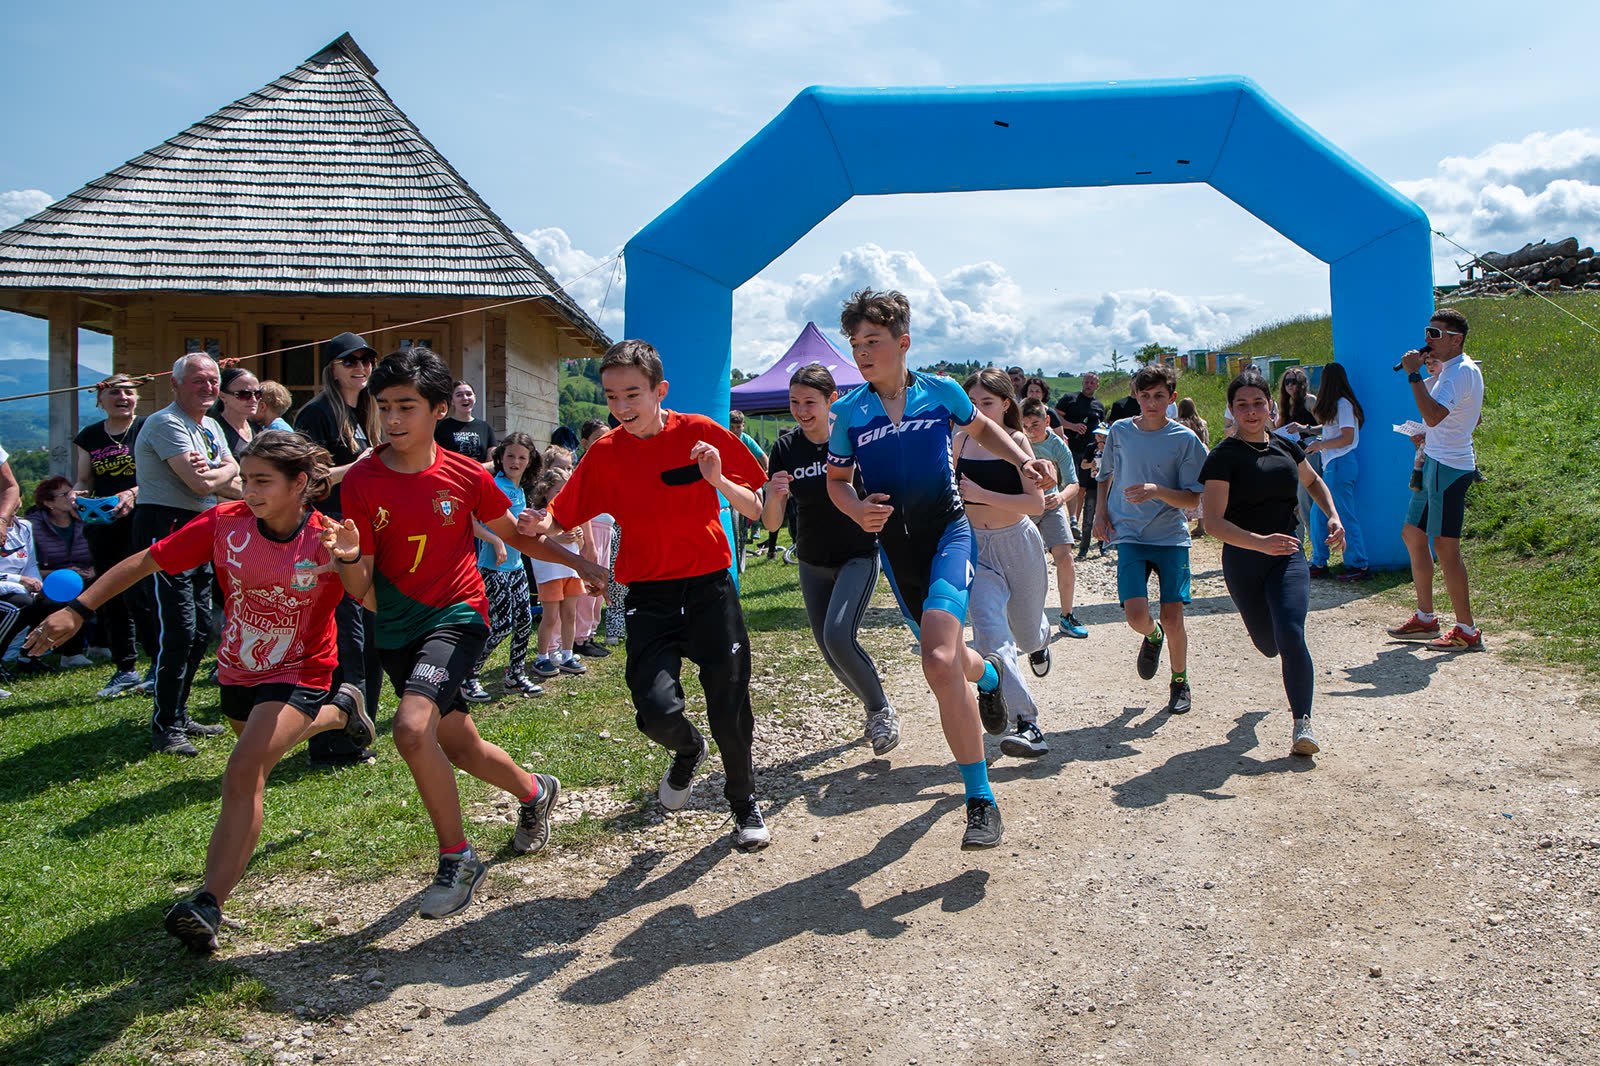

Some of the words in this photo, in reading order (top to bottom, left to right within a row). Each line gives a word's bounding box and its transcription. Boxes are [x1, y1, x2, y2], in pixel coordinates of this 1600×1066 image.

[857, 418, 942, 447] GIANT
[793, 461, 828, 480] adi
[407, 534, 427, 573] 7
[244, 611, 296, 633] LIVEROL
[272, 628, 292, 636] CLUB
